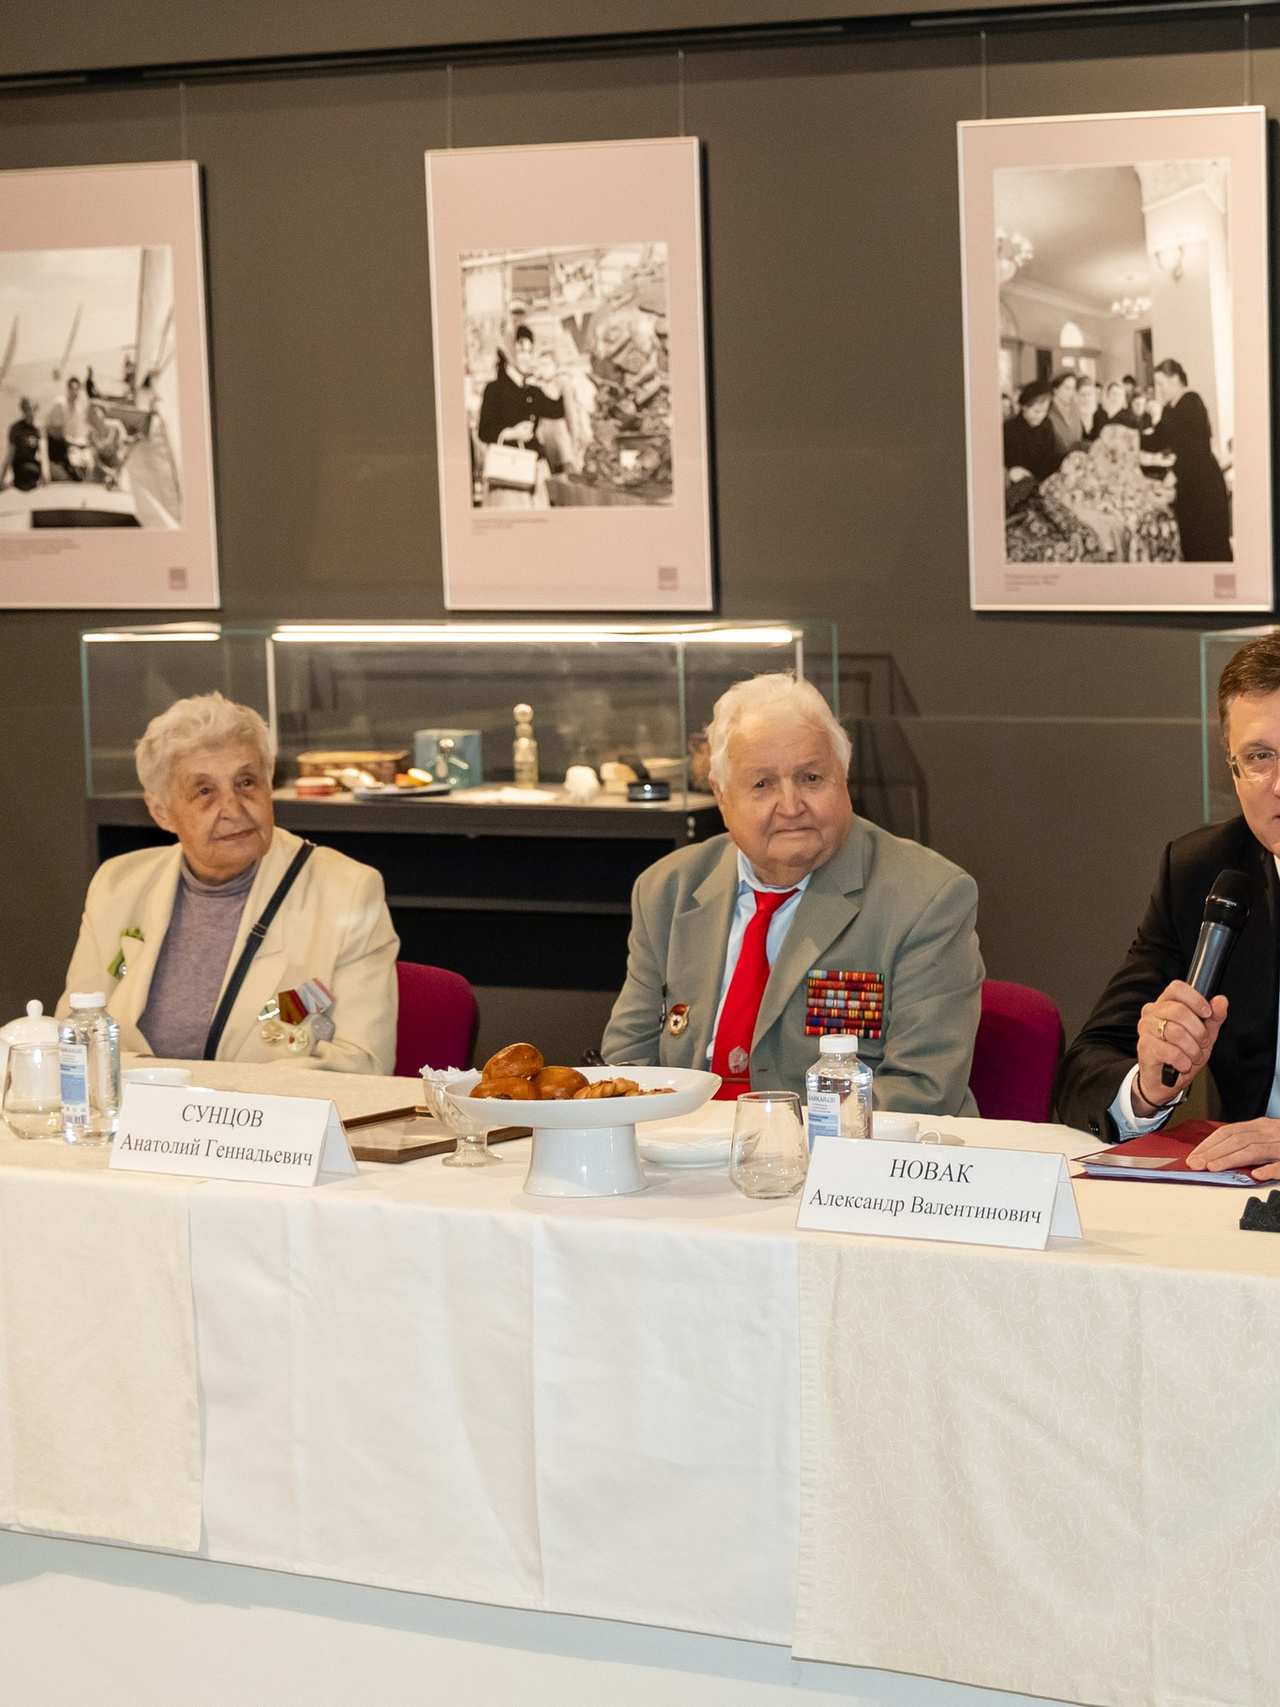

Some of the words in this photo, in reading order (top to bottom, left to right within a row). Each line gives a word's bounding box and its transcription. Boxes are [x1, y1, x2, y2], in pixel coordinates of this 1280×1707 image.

[181, 1104, 264, 1129] СУНЦОВ
[119, 1133, 201, 1156] Анатолий
[205, 1139, 314, 1166] Геннадьевич
[889, 1158, 973, 1184] НОВАК
[809, 1188, 906, 1216] Александр
[911, 1196, 1042, 1223] Валентинович
